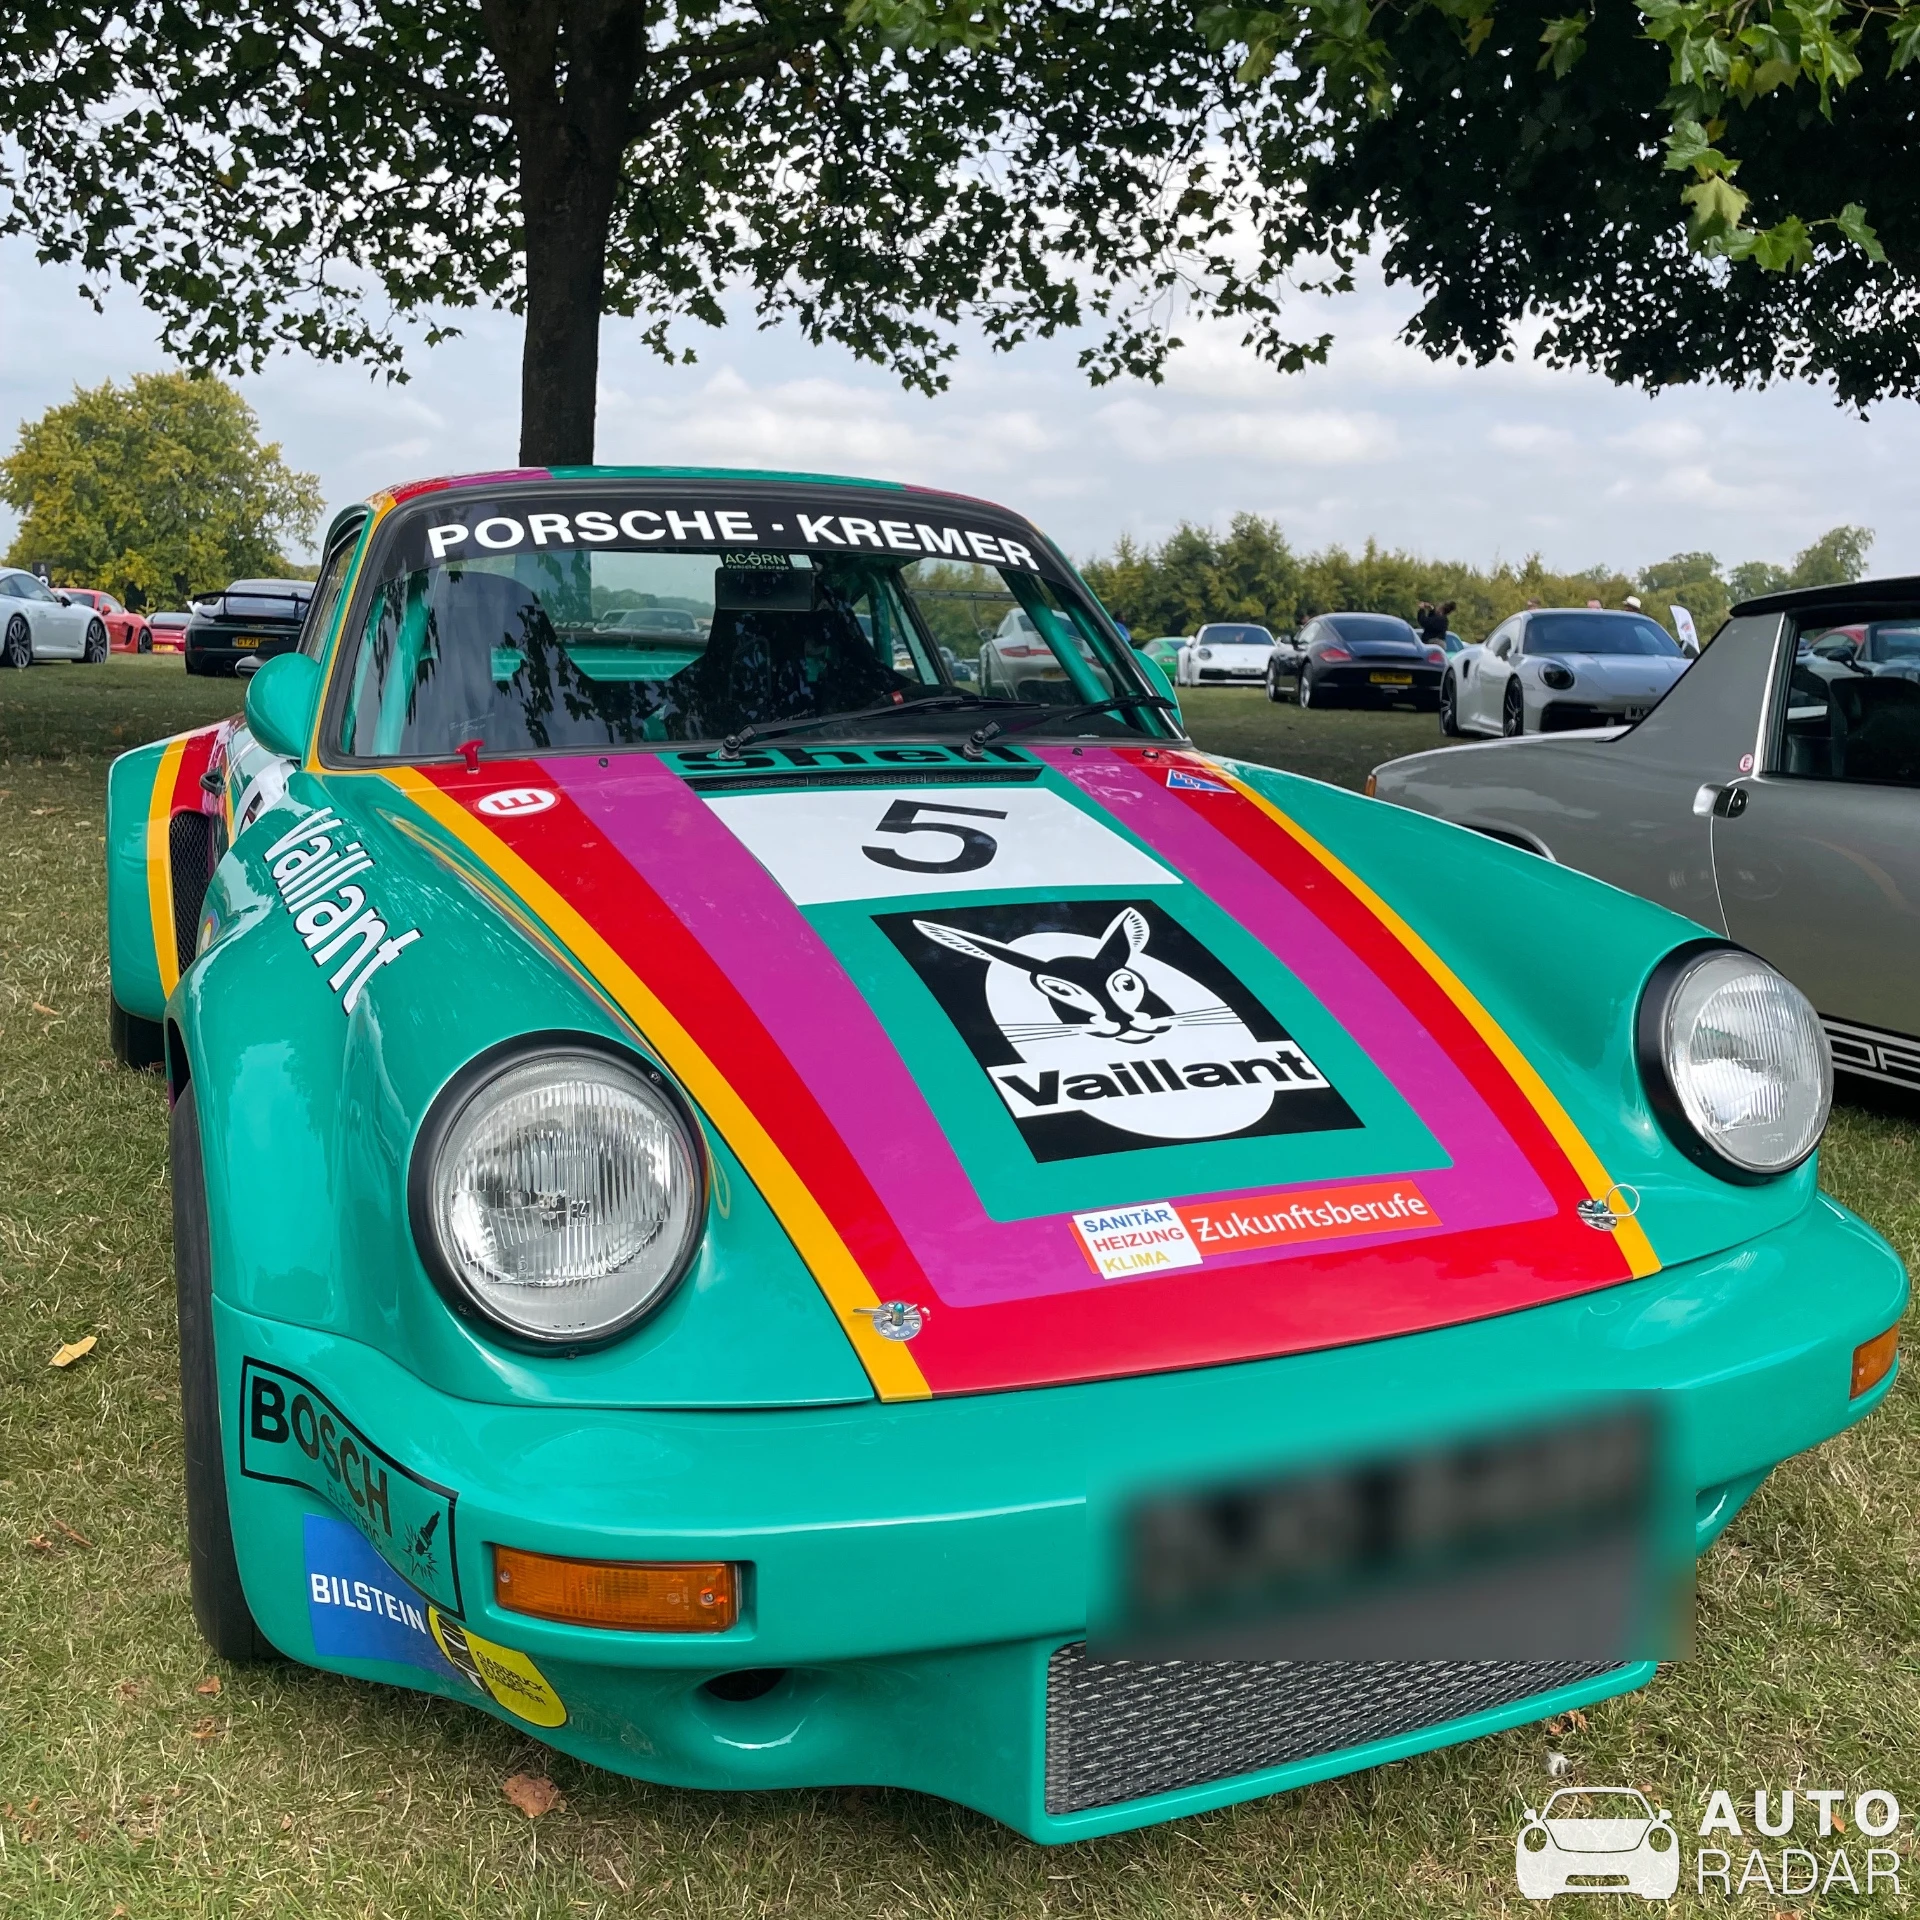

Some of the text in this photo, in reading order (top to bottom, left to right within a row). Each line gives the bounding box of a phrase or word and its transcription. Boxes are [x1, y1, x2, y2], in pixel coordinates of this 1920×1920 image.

[427, 510, 759, 559] PORSCHE
[796, 514, 1040, 571] KREMER
[725, 551, 787, 566] ACORN
[490, 793, 544, 811] E
[861, 798, 1008, 874] 5
[263, 806, 424, 1017] Vaillant
[997, 1050, 1319, 1107] Vaillant
[1083, 1209, 1173, 1233] SANITÄR
[1092, 1227, 1185, 1253] HEIZUNG
[1191, 1193, 1428, 1242] Zukunftsberufe
[1103, 1250, 1171, 1273] KLIMA
[251, 1375, 393, 1538] BOSCH
[326, 1478, 383, 1550] ELECTRIC
[310, 1573, 427, 1635] BILSTEIN
